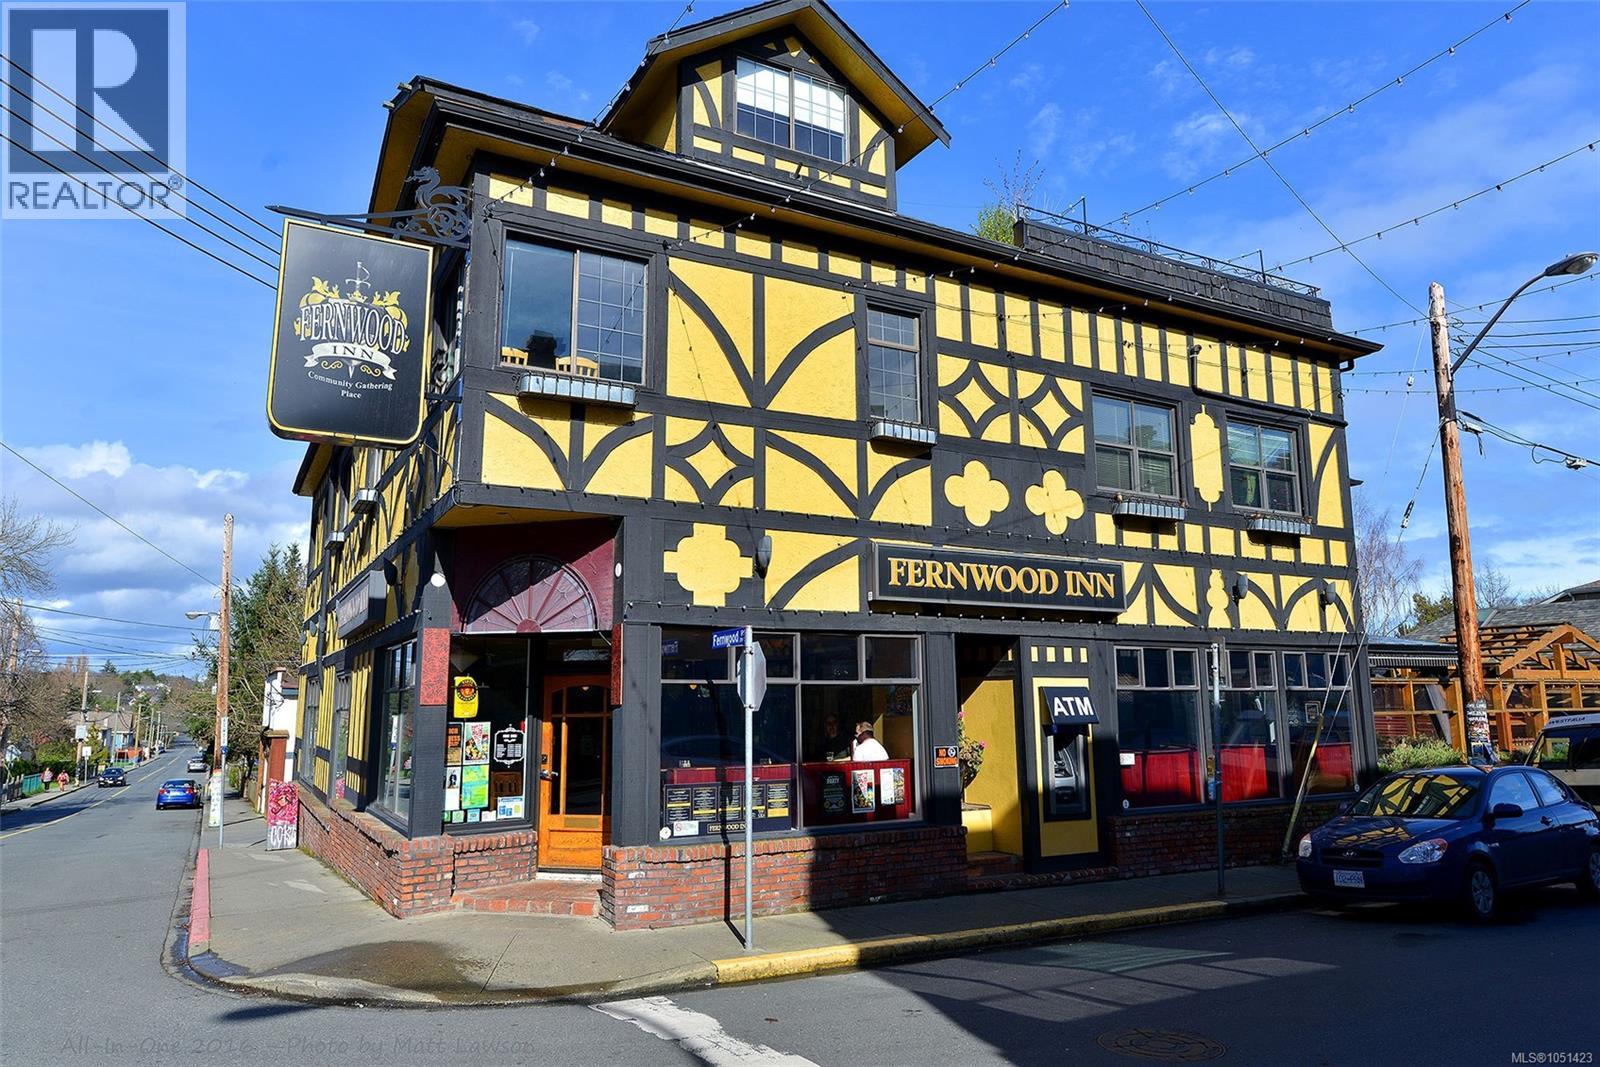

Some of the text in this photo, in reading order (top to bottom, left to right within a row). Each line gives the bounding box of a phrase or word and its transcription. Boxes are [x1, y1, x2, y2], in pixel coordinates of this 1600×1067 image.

[300, 302, 405, 355] FERNWOOD
[332, 345, 374, 360] INN
[308, 371, 393, 391] Community Gathering
[341, 390, 362, 399] Place
[888, 558, 1116, 598] FERNWOOD INN
[713, 631, 739, 647] Fernwood
[1054, 696, 1094, 716] ATM
